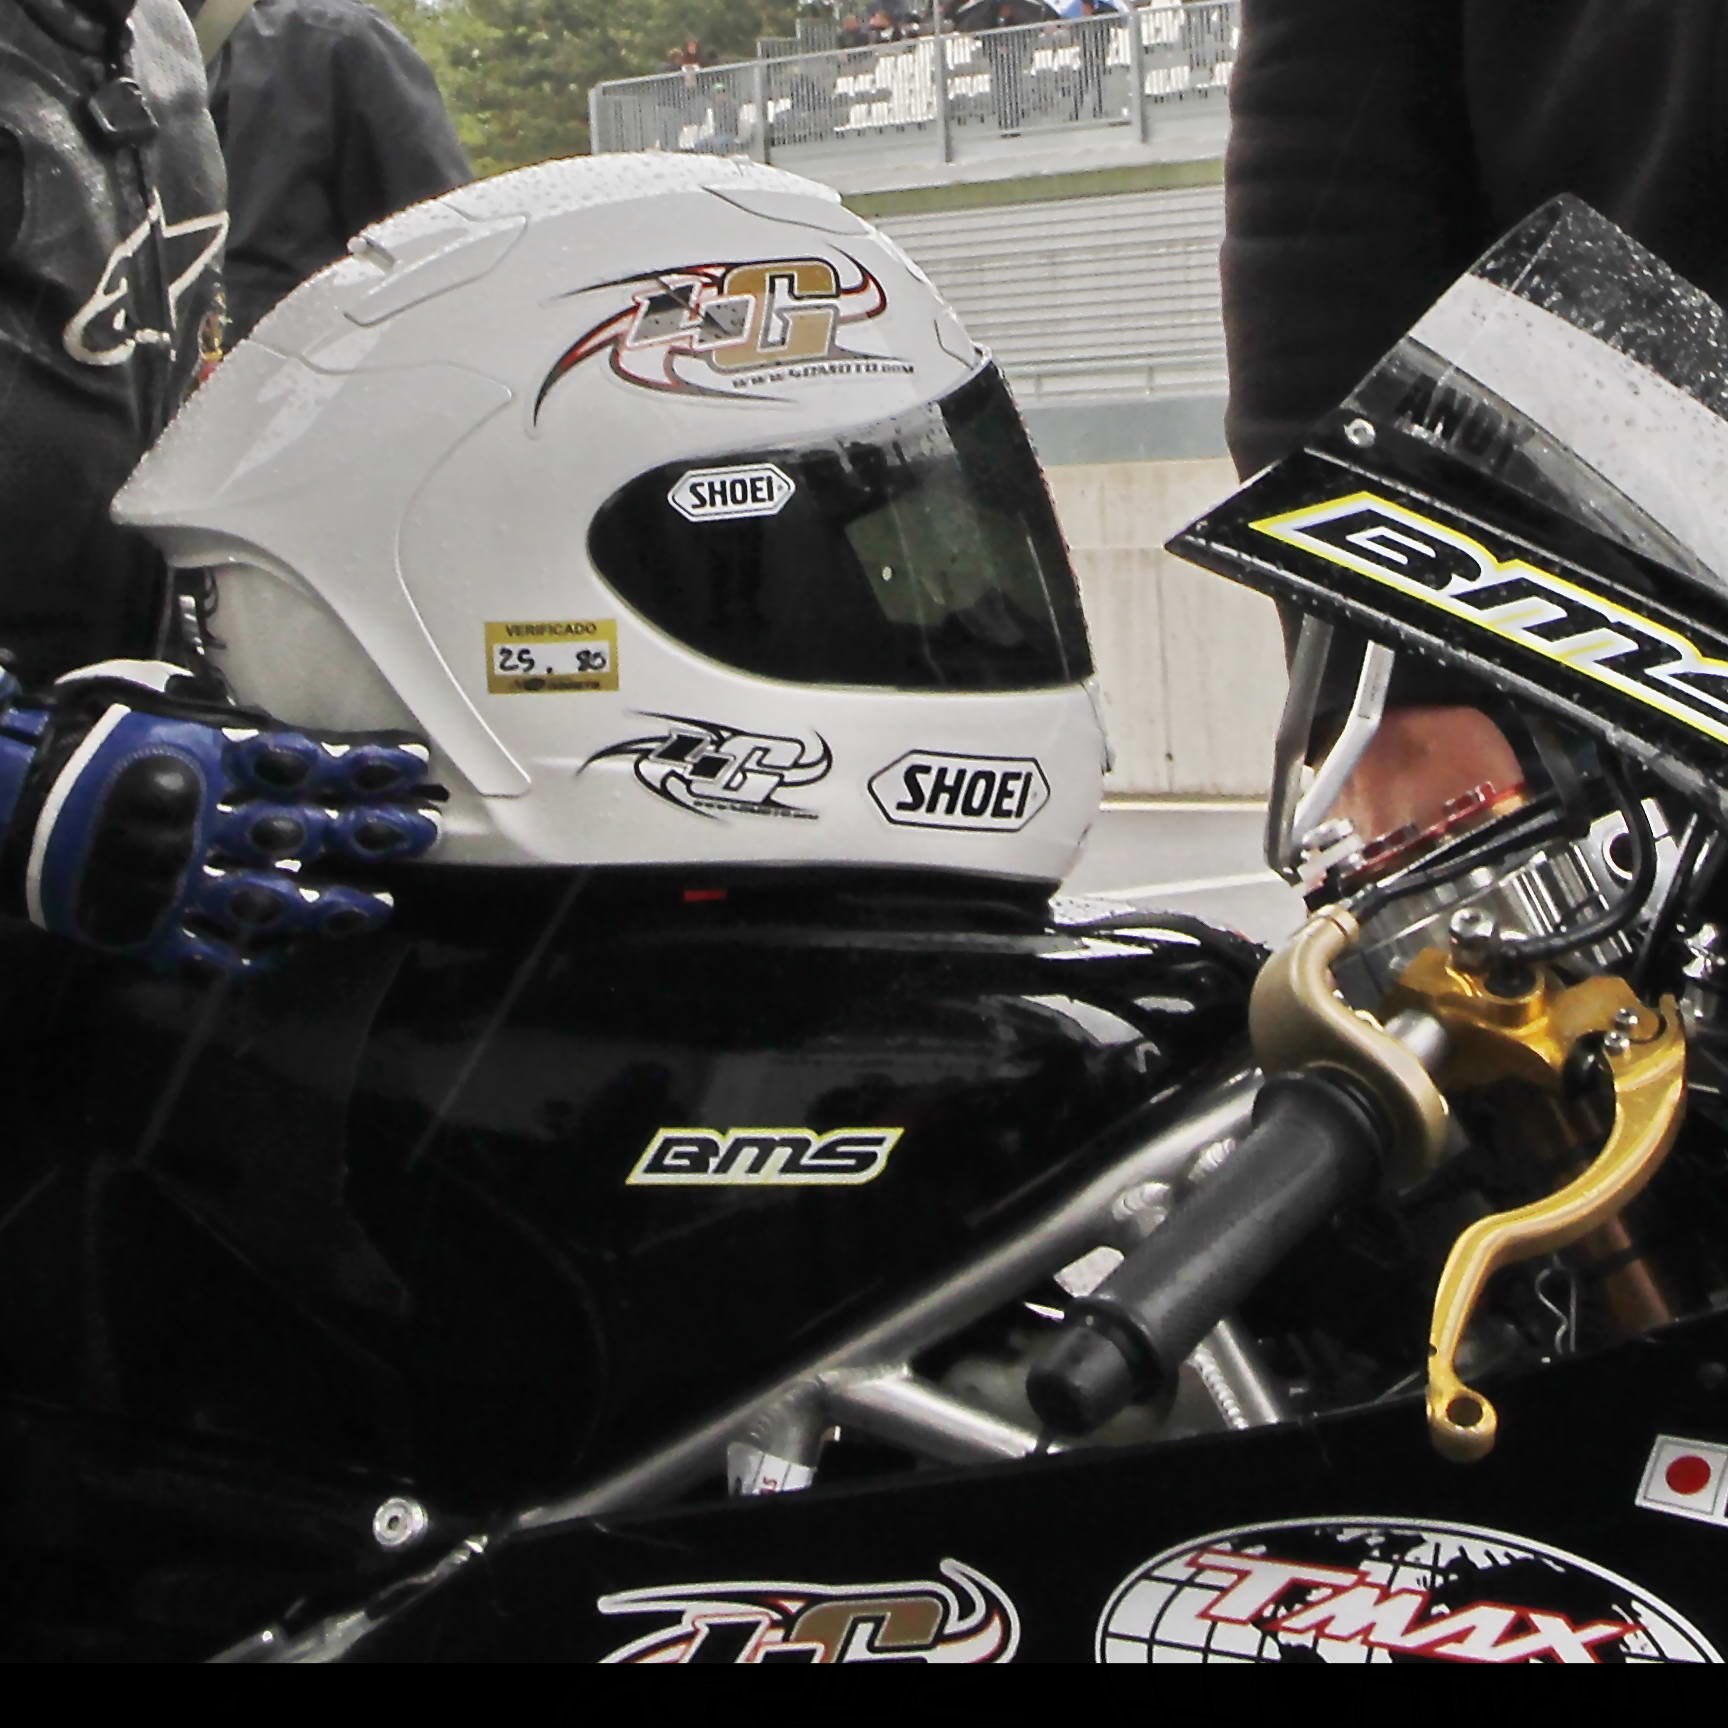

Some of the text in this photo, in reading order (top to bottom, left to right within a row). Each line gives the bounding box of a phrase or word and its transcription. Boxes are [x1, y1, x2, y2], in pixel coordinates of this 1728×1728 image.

[689, 475, 774, 509] SHOEI
[895, 763, 1033, 818] SHOEI
[1184, 1548, 1648, 1663] TMAX
